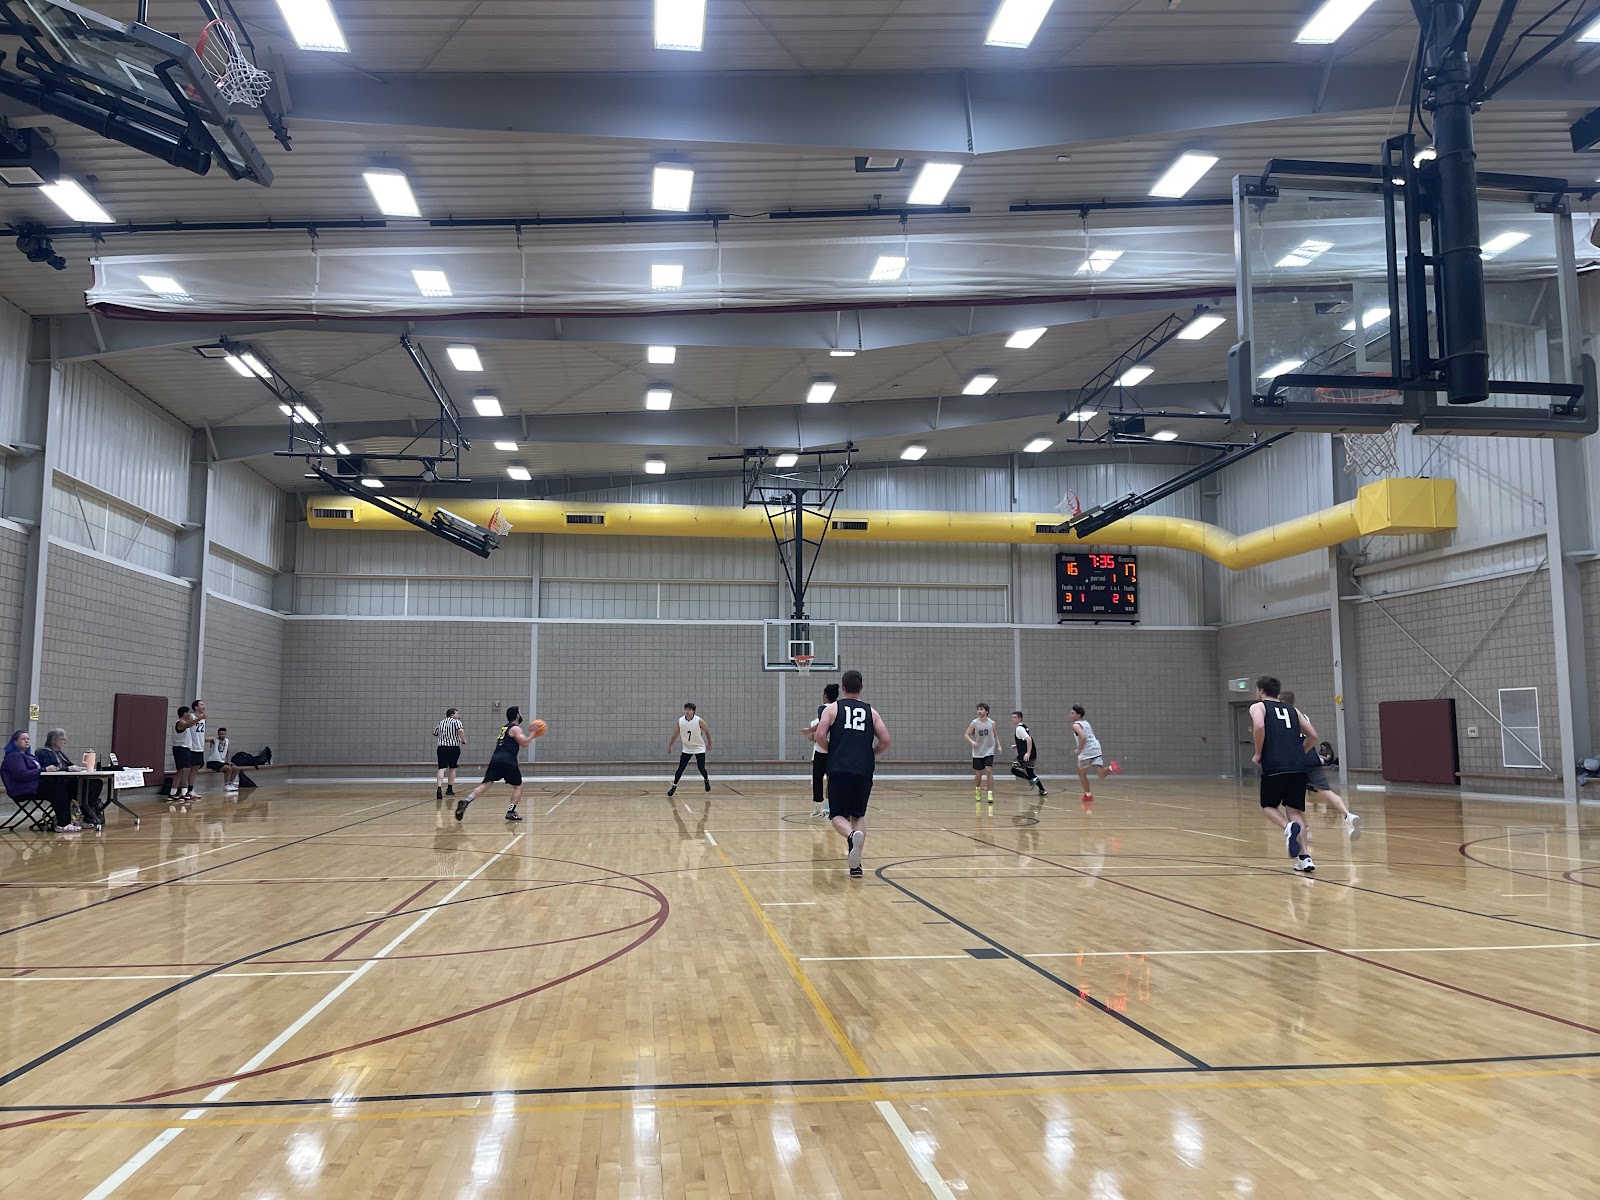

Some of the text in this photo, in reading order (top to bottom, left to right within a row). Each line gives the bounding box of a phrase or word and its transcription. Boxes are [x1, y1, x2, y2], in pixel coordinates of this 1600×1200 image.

[1089, 555, 1115, 568] 7:35
[1067, 562, 1078, 575] 16
[1125, 563, 1136, 576] 17
[1065, 592, 1072, 603] 3
[1112, 593, 1119, 604] 2
[1127, 594, 1134, 603] 4
[844, 706, 866, 731] 12
[1274, 707, 1292, 729] 4
[195, 722, 205, 733] 22
[687, 730, 692, 741] 7
